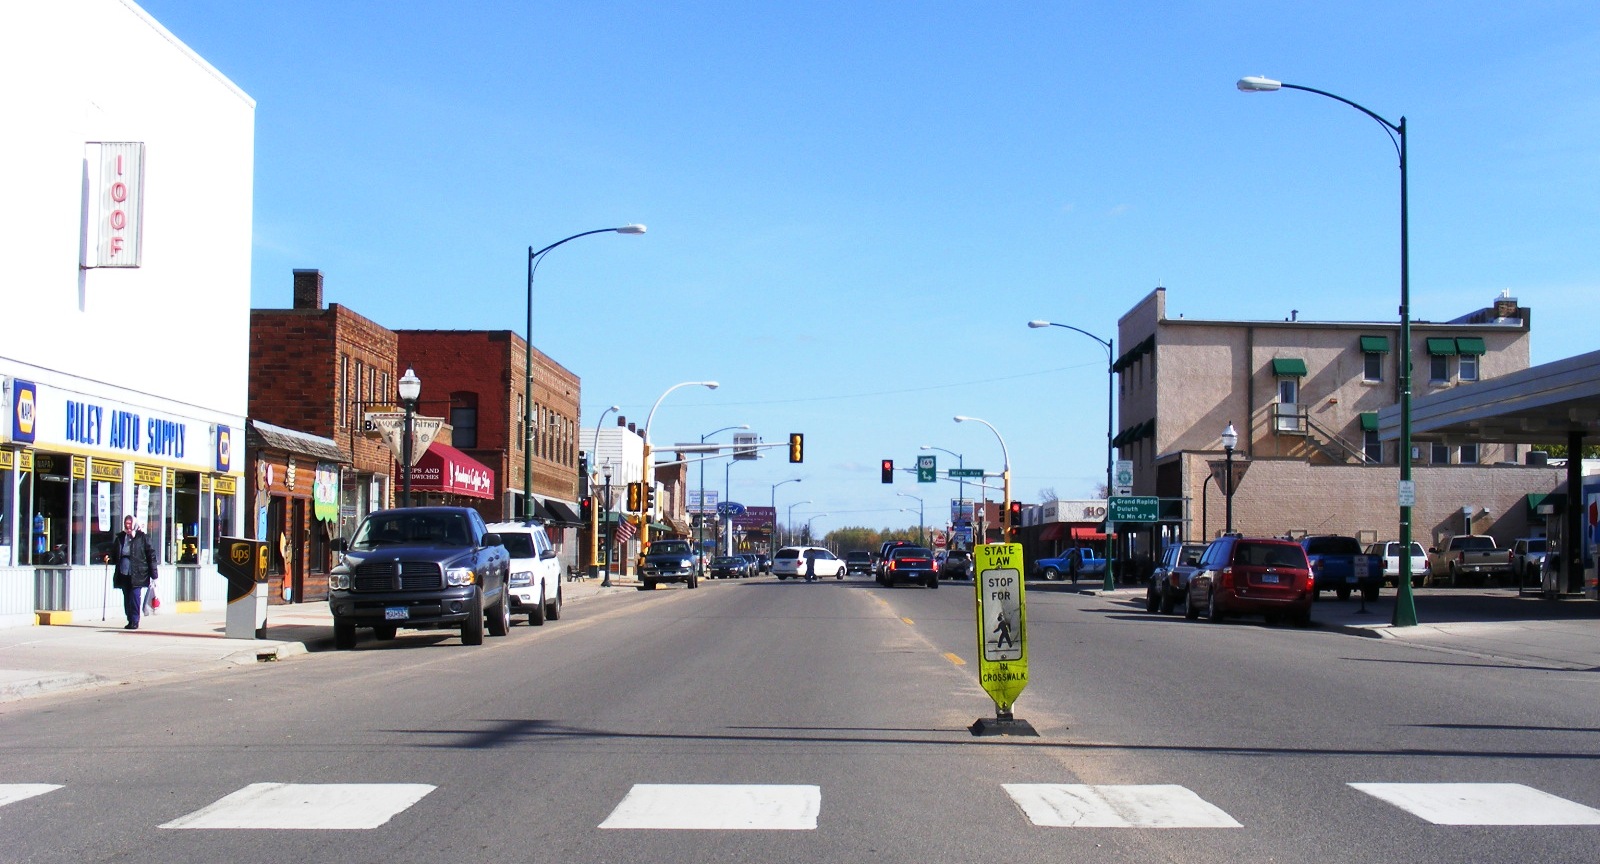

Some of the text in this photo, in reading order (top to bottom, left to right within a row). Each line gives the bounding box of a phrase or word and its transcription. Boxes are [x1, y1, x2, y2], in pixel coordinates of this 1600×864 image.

[110, 154, 127, 257] IOOF
[20, 401, 33, 421] NAPA
[66, 400, 186, 459] RILEY AUTO SUPPLY
[232, 549, 248, 562] ups
[984, 546, 1015, 556] STATE
[989, 557, 1010, 567] LAW
[988, 578, 1014, 588] STOP
[992, 592, 1011, 601] FOR
[999, 663, 1009, 671] IN
[983, 672, 1026, 683] CROSSWALK
